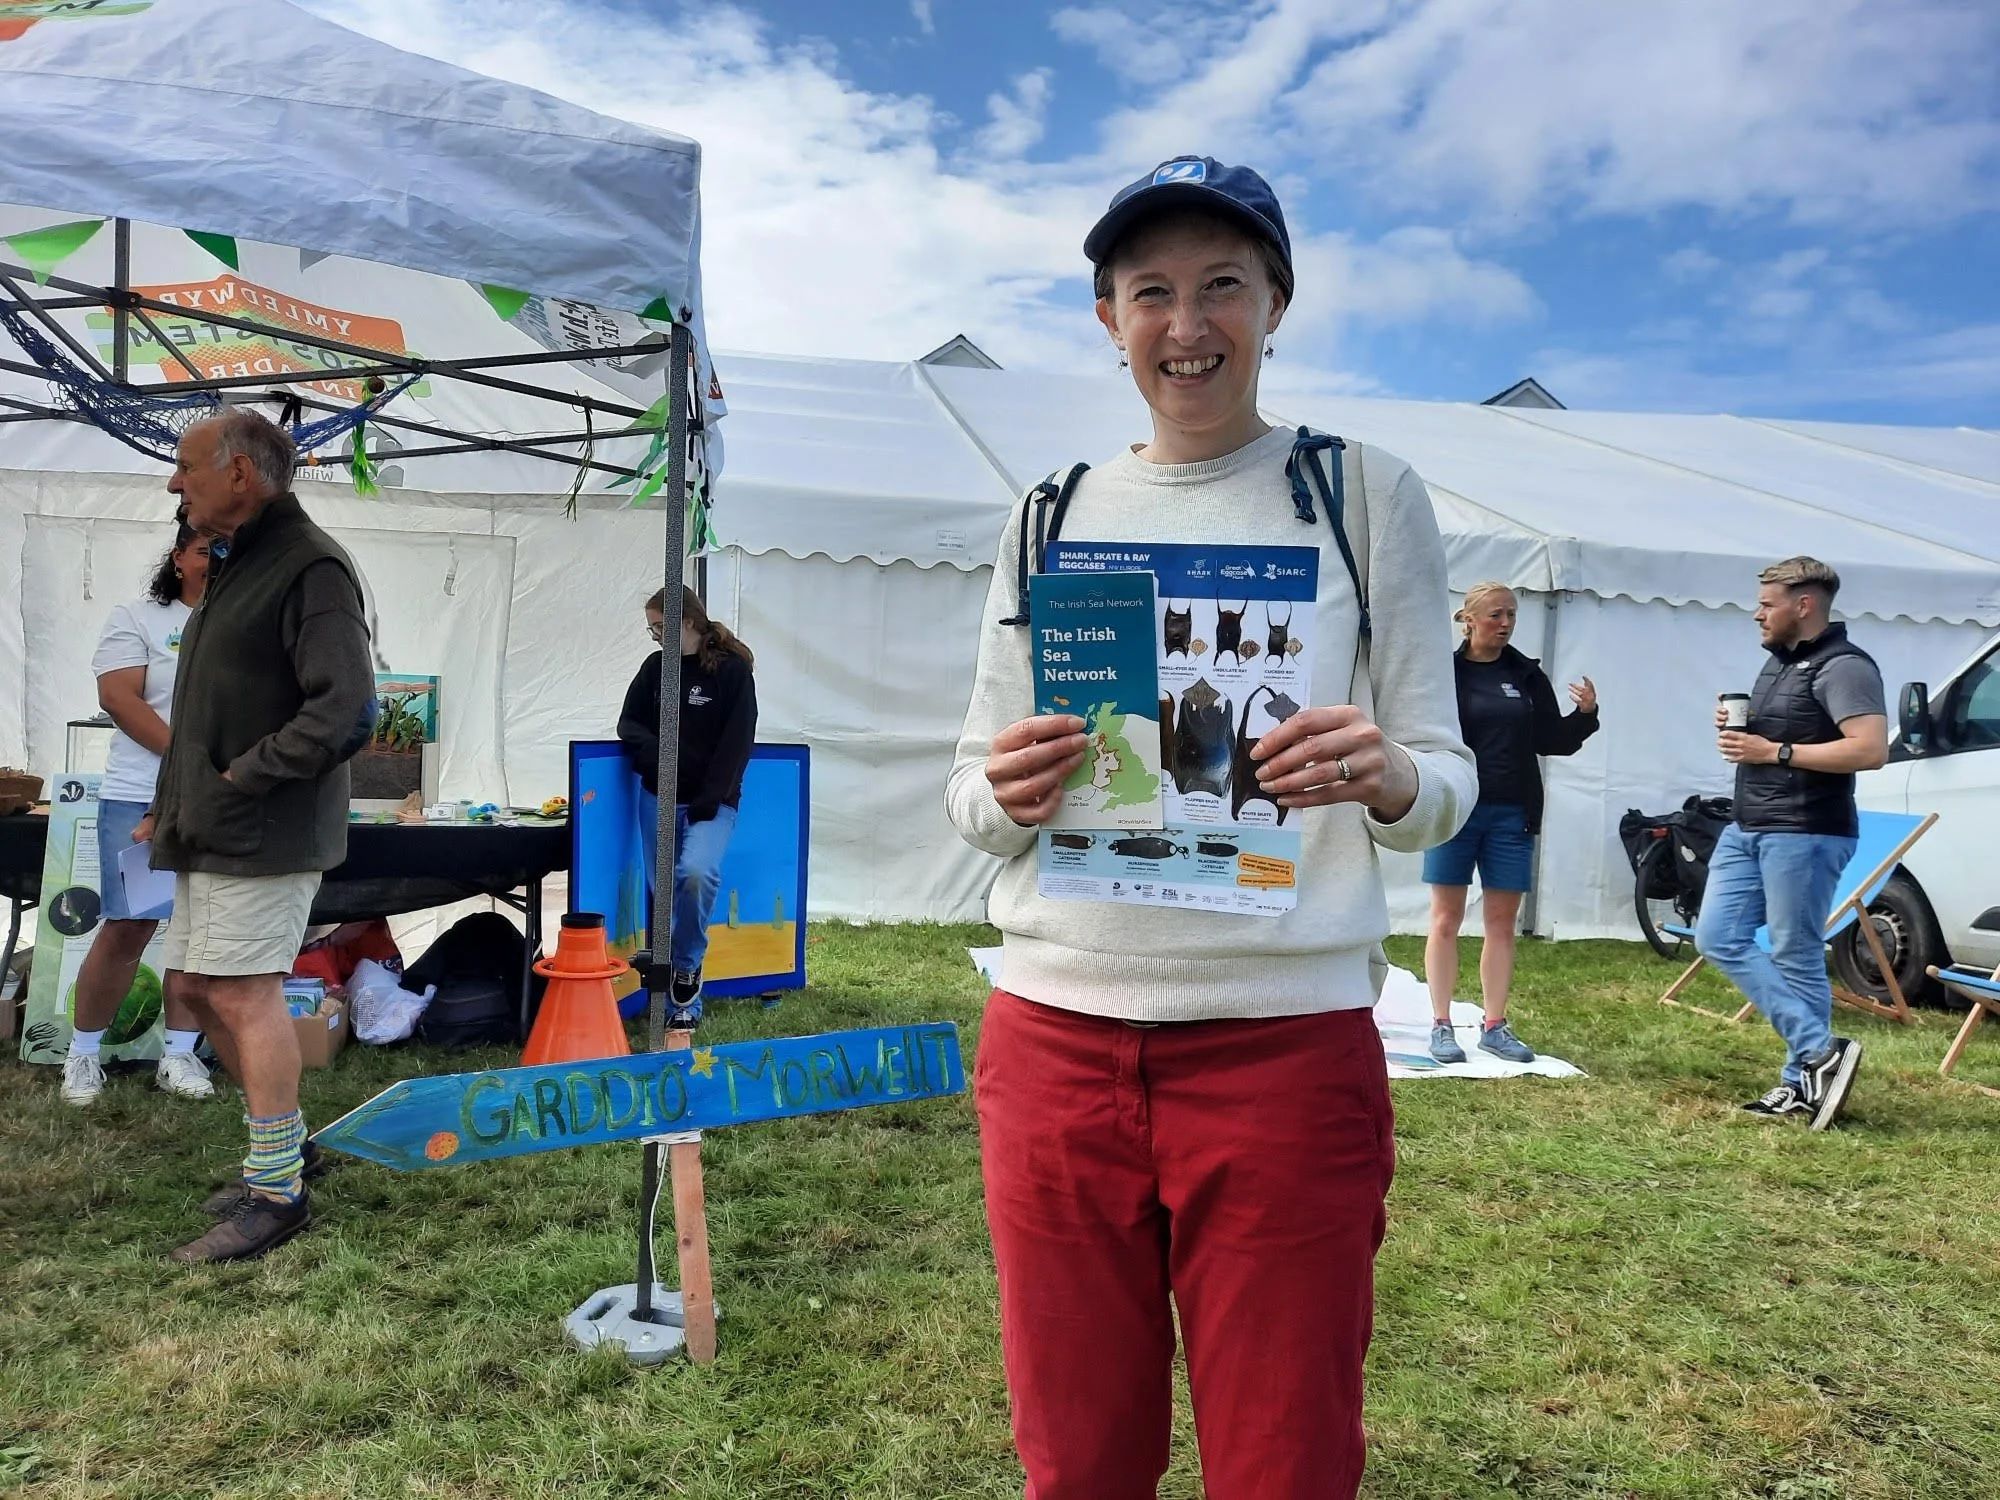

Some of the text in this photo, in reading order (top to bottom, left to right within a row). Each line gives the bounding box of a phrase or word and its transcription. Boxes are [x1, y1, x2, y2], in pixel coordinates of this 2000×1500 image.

[1059, 551, 1151, 562] SHARK, SKATE & RAY
[1058, 561, 1106, 570] EGGCASES
[1220, 569, 1248, 578] Eggcase
[1277, 568, 1307, 576] SIARC
[1049, 598, 1144, 609] The Irish Sea Network
[1041, 627, 1117, 643] The Irish
[1042, 649, 1071, 662] Sea
[1043, 667, 1118, 682] Network
[1161, 888, 1178, 896] ZSL
